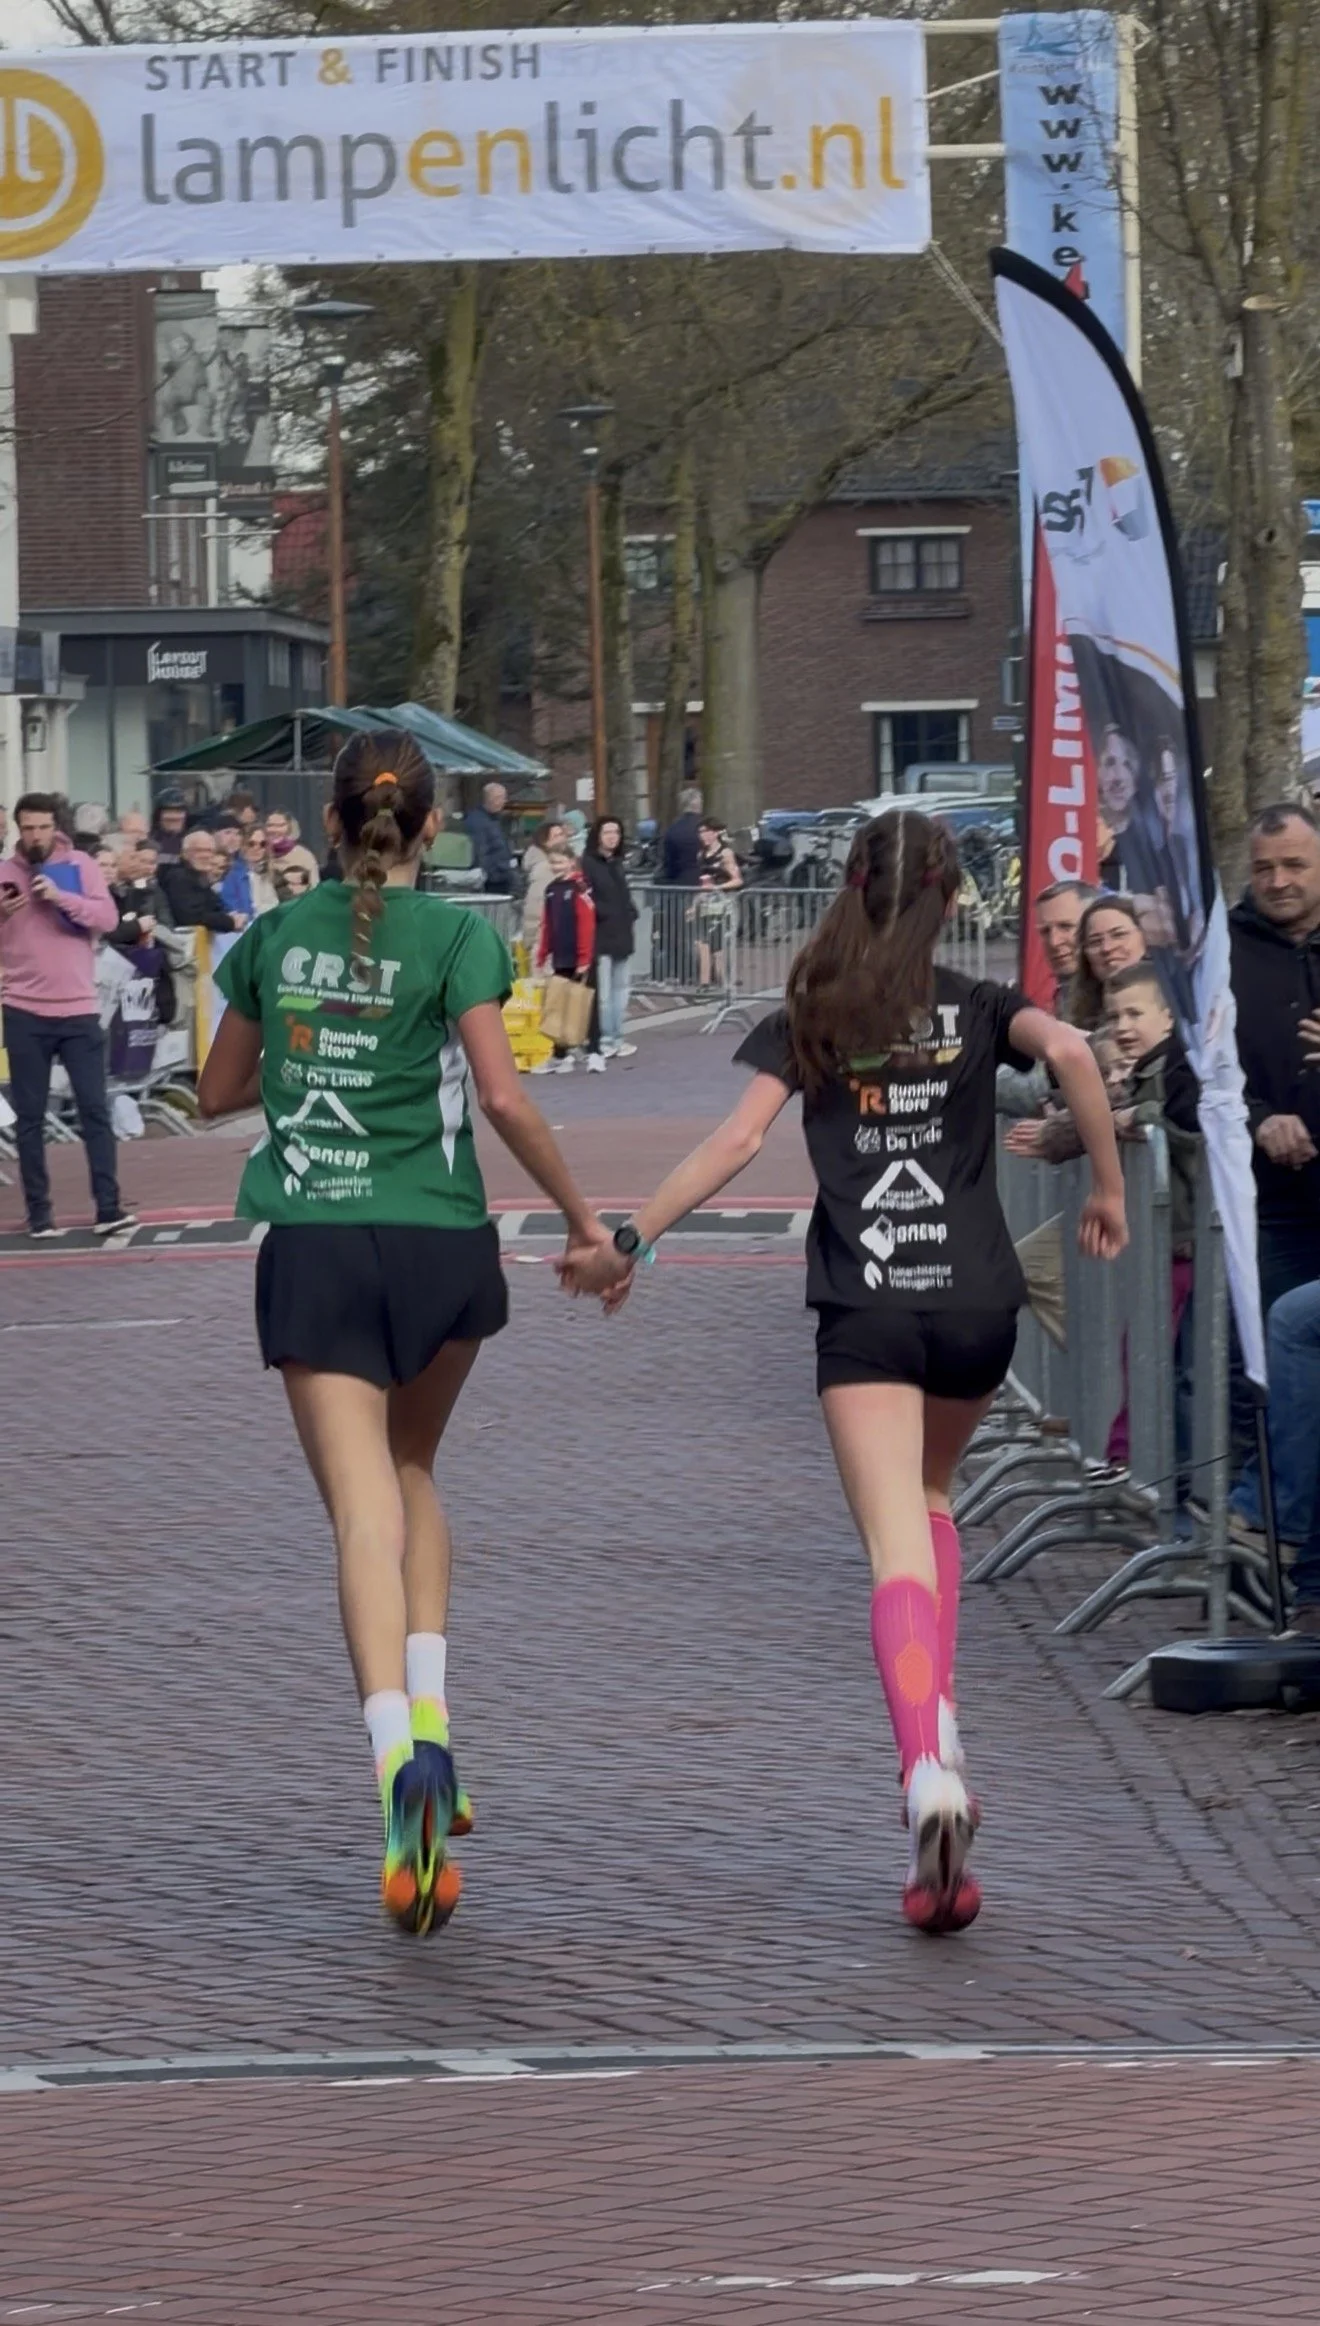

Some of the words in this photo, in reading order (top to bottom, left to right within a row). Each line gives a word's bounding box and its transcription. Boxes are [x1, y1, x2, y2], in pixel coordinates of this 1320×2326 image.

[145, 51, 296, 91] START
[317, 47, 352, 86] &
[377, 43, 541, 84] FINISH
[141, 97, 906, 229] lampenlicht.nl
[1028, 82, 1088, 300] www.ke
[281, 946, 402, 995] CRST
[317, 1042, 357, 1060] Store
[319, 1027, 379, 1052] Running
[888, 1078, 949, 1099] Running
[889, 1098, 930, 1114] Store
